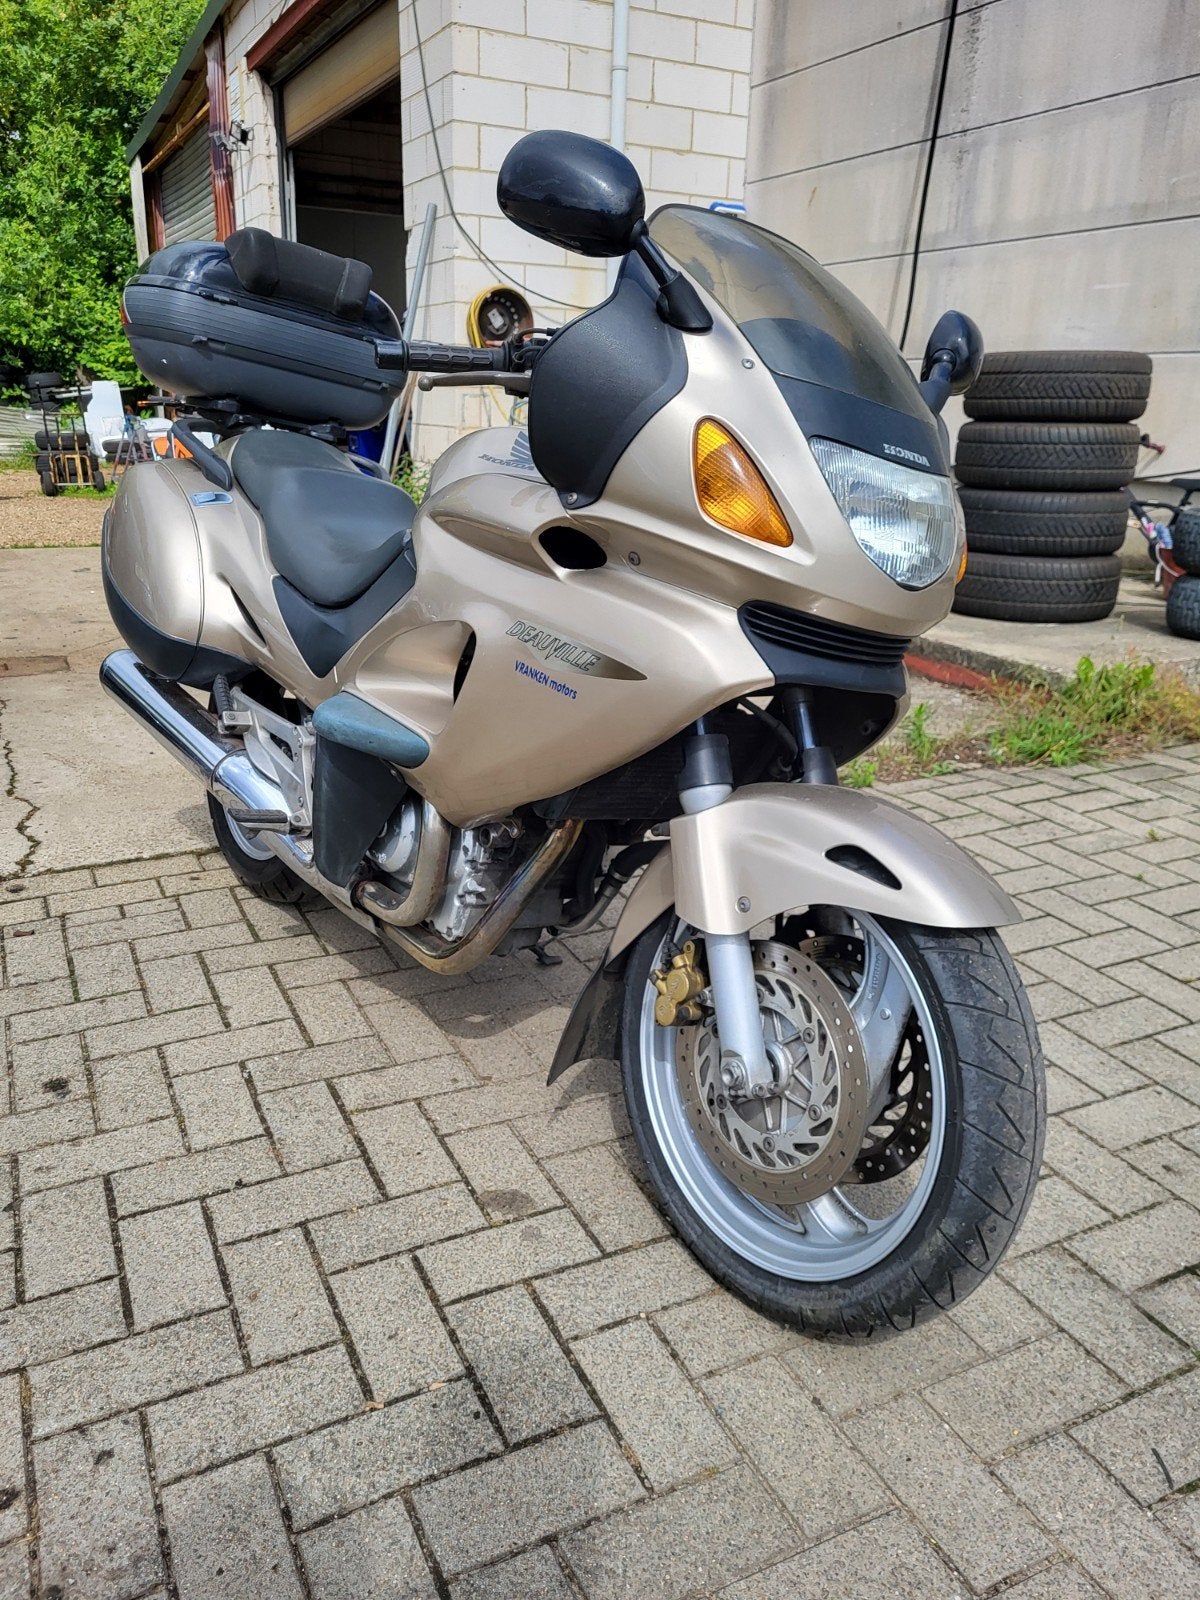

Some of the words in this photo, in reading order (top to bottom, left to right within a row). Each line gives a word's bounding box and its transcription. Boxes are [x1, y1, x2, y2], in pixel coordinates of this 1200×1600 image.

[478, 453, 535, 471] HONDA
[883, 443, 930, 467] HONDA
[505, 620, 601, 672] DEAUVILLE
[515, 659, 549, 687] VRANKEN
[549, 678, 578, 700] motors
